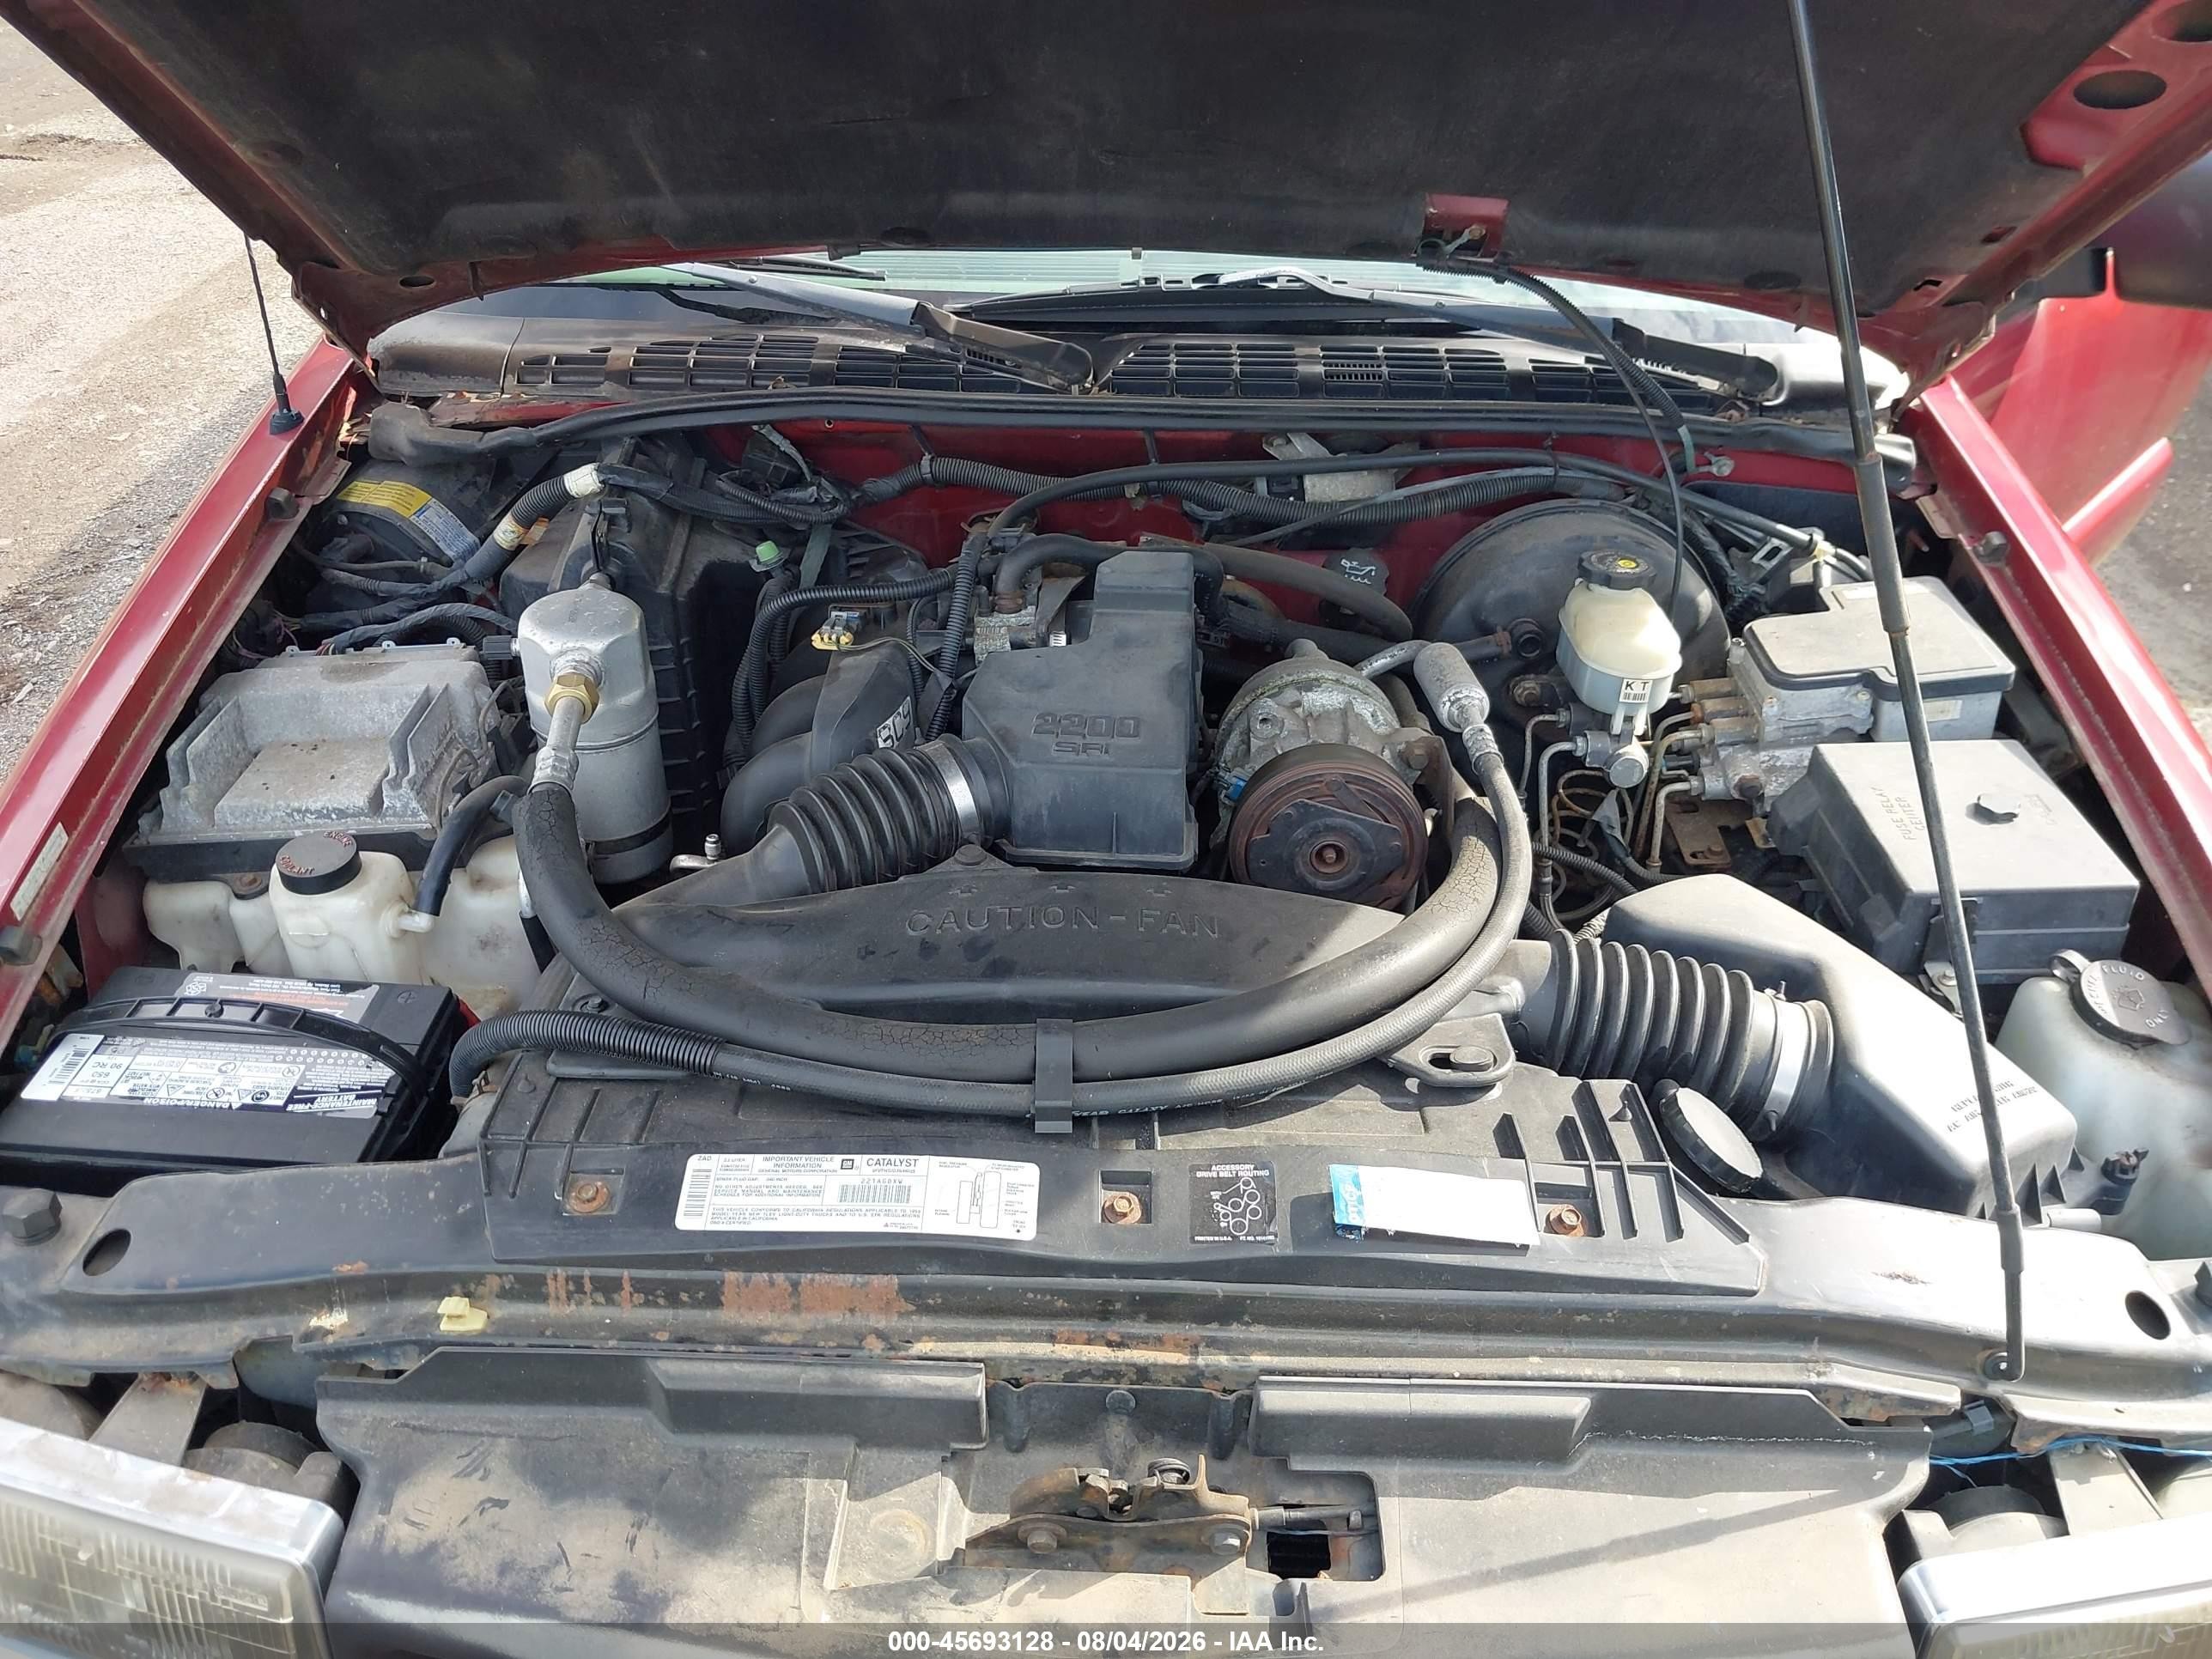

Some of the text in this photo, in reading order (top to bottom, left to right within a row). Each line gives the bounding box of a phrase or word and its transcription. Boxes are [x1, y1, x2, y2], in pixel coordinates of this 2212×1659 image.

[1031, 713, 1141, 741] 2200
[1895, 819, 1915, 841] FUSE
[905, 905, 1100, 936] CAUTION
[1138, 908, 1219, 939] FAN
[2102, 964, 2145, 981] FLUID
[285, 1098, 378, 1111] MAINTENANCE-FREE
[315, 1094, 356, 1103] BATTERY
[866, 1158, 919, 1167] CATALYST
